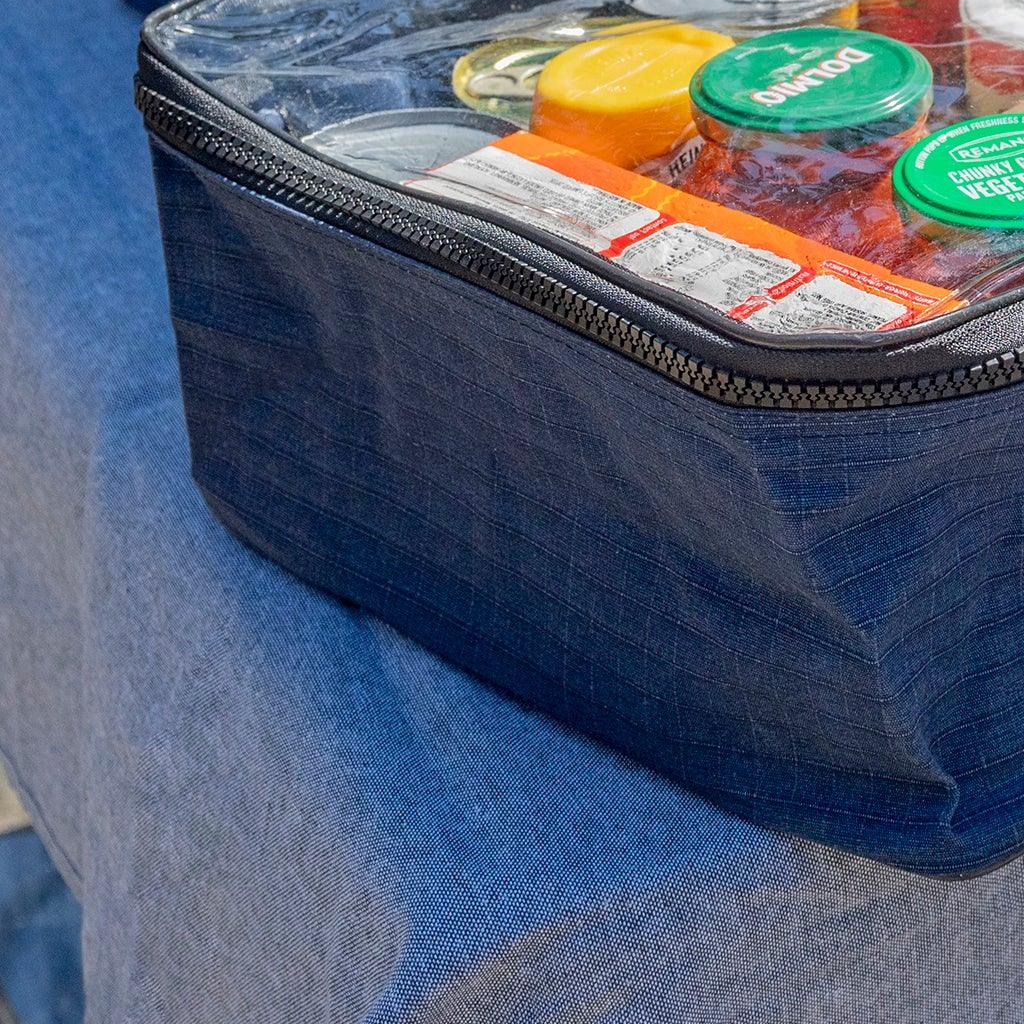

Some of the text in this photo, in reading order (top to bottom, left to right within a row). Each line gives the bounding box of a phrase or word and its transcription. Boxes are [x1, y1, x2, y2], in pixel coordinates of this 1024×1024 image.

[750, 46, 874, 106] DOLMIO
[947, 124, 971, 137] WHEN
[971, 116, 1019, 132] FRESHNESS
[947, 160, 1016, 185] CHUNKY
